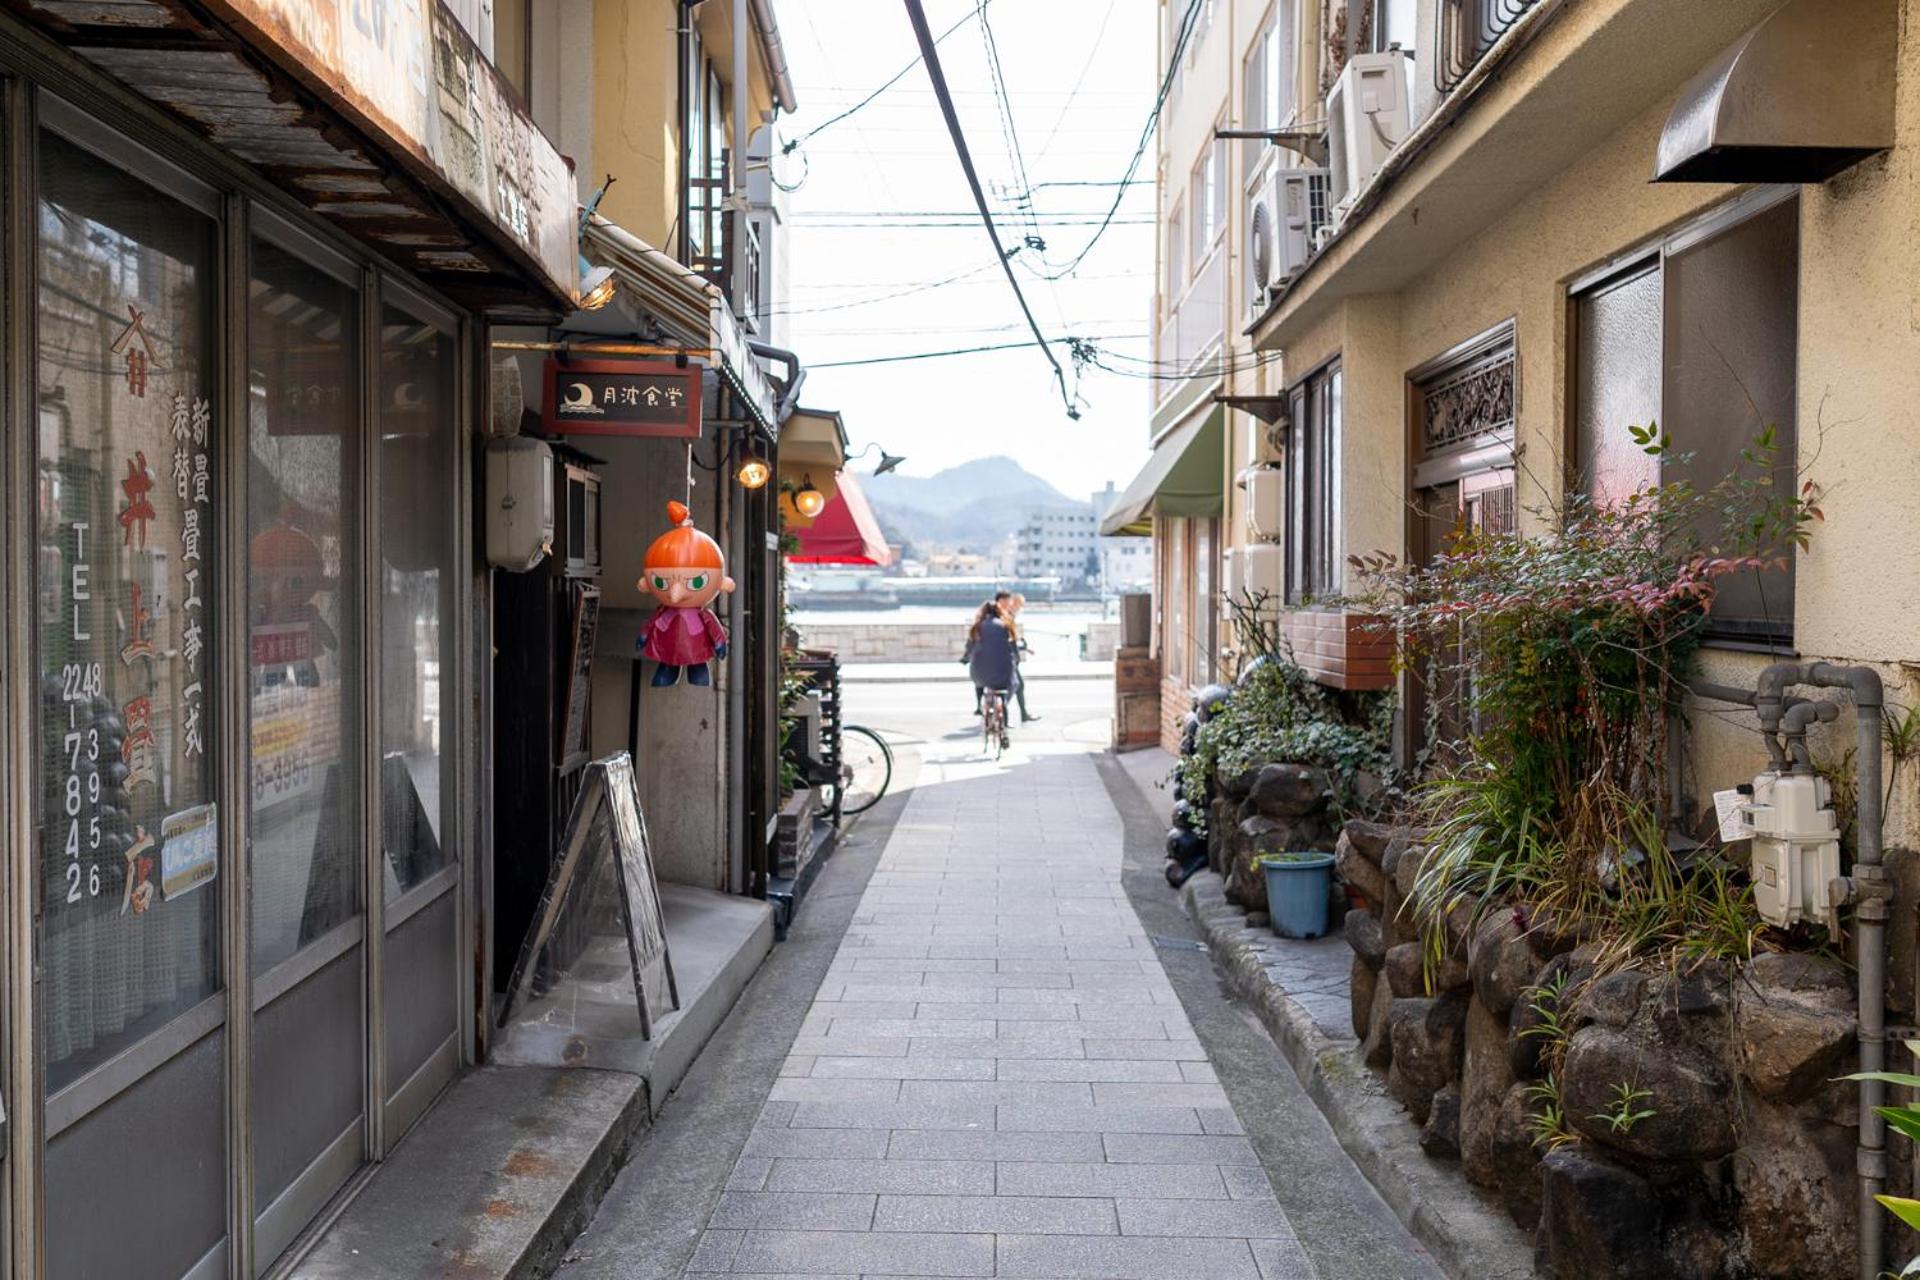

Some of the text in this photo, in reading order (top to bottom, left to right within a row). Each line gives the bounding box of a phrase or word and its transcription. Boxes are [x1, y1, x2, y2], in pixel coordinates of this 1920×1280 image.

[172, 391, 191, 500] 表替
[193, 396, 210, 502] 新畳
[603, 385, 683, 407] 月波食堂
[72, 522, 91, 641] TEL
[181, 508, 203, 758] 畳工事一式
